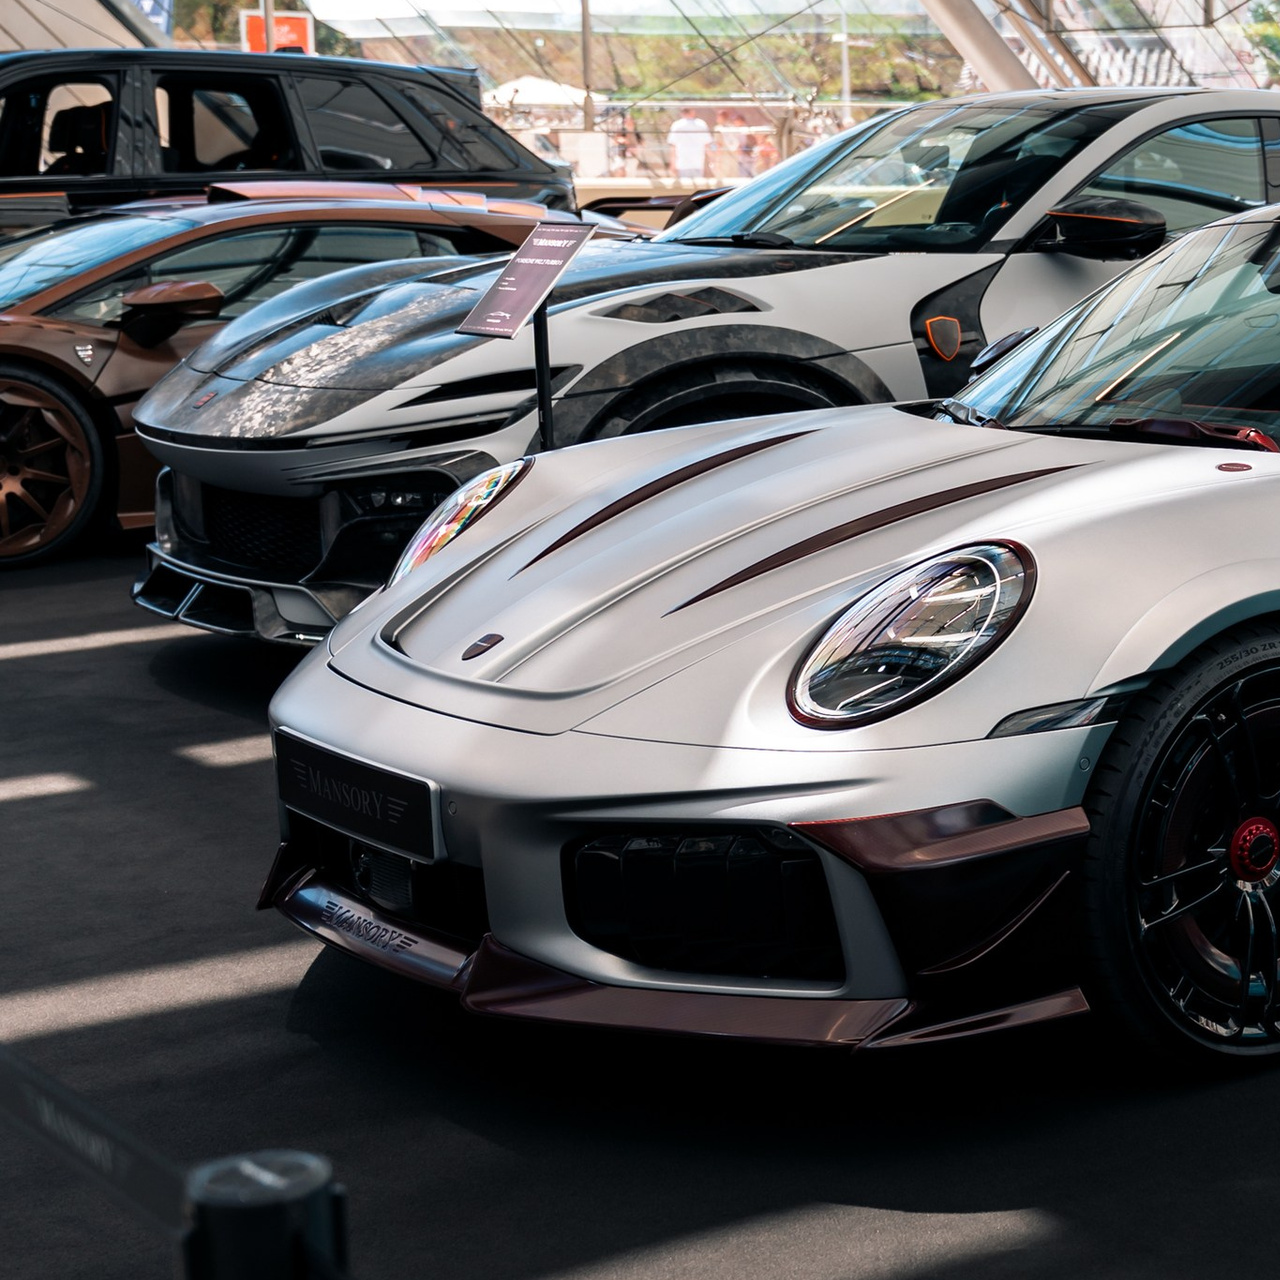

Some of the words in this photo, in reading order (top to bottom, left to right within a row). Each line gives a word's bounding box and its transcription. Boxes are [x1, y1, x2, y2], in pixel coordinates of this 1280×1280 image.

[1216, 646, 1259, 670] 255/30
[1260, 641, 1278, 651] ZR
[308, 766, 385, 820] MANSORY
[330, 904, 402, 952] MANSORY
